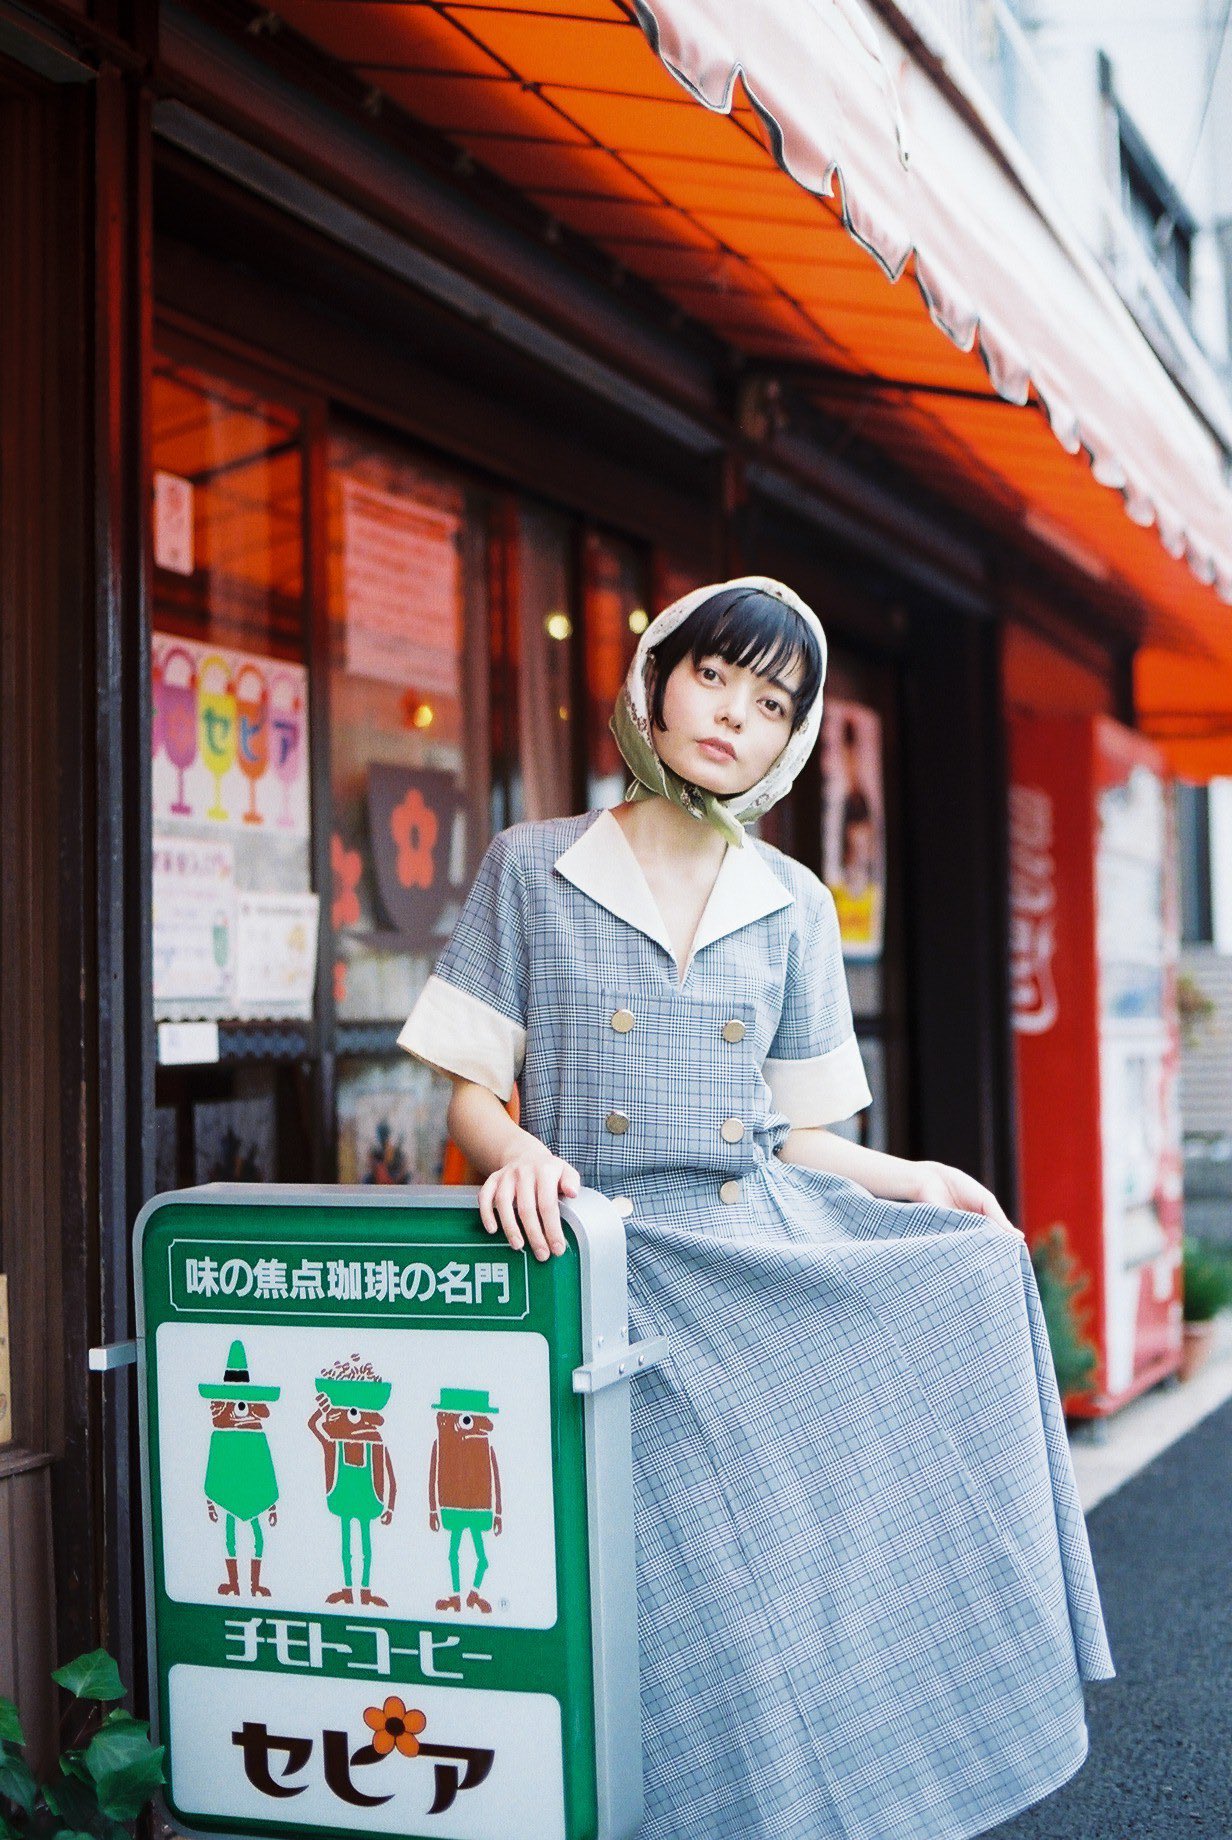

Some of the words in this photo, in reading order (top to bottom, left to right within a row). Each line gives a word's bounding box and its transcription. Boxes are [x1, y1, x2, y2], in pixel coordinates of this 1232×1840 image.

[186, 1256, 509, 1304] 味の焦点珈琲の名門
[225, 1617, 492, 1679] チモトコーヒー
[232, 1697, 495, 1814] セピア
